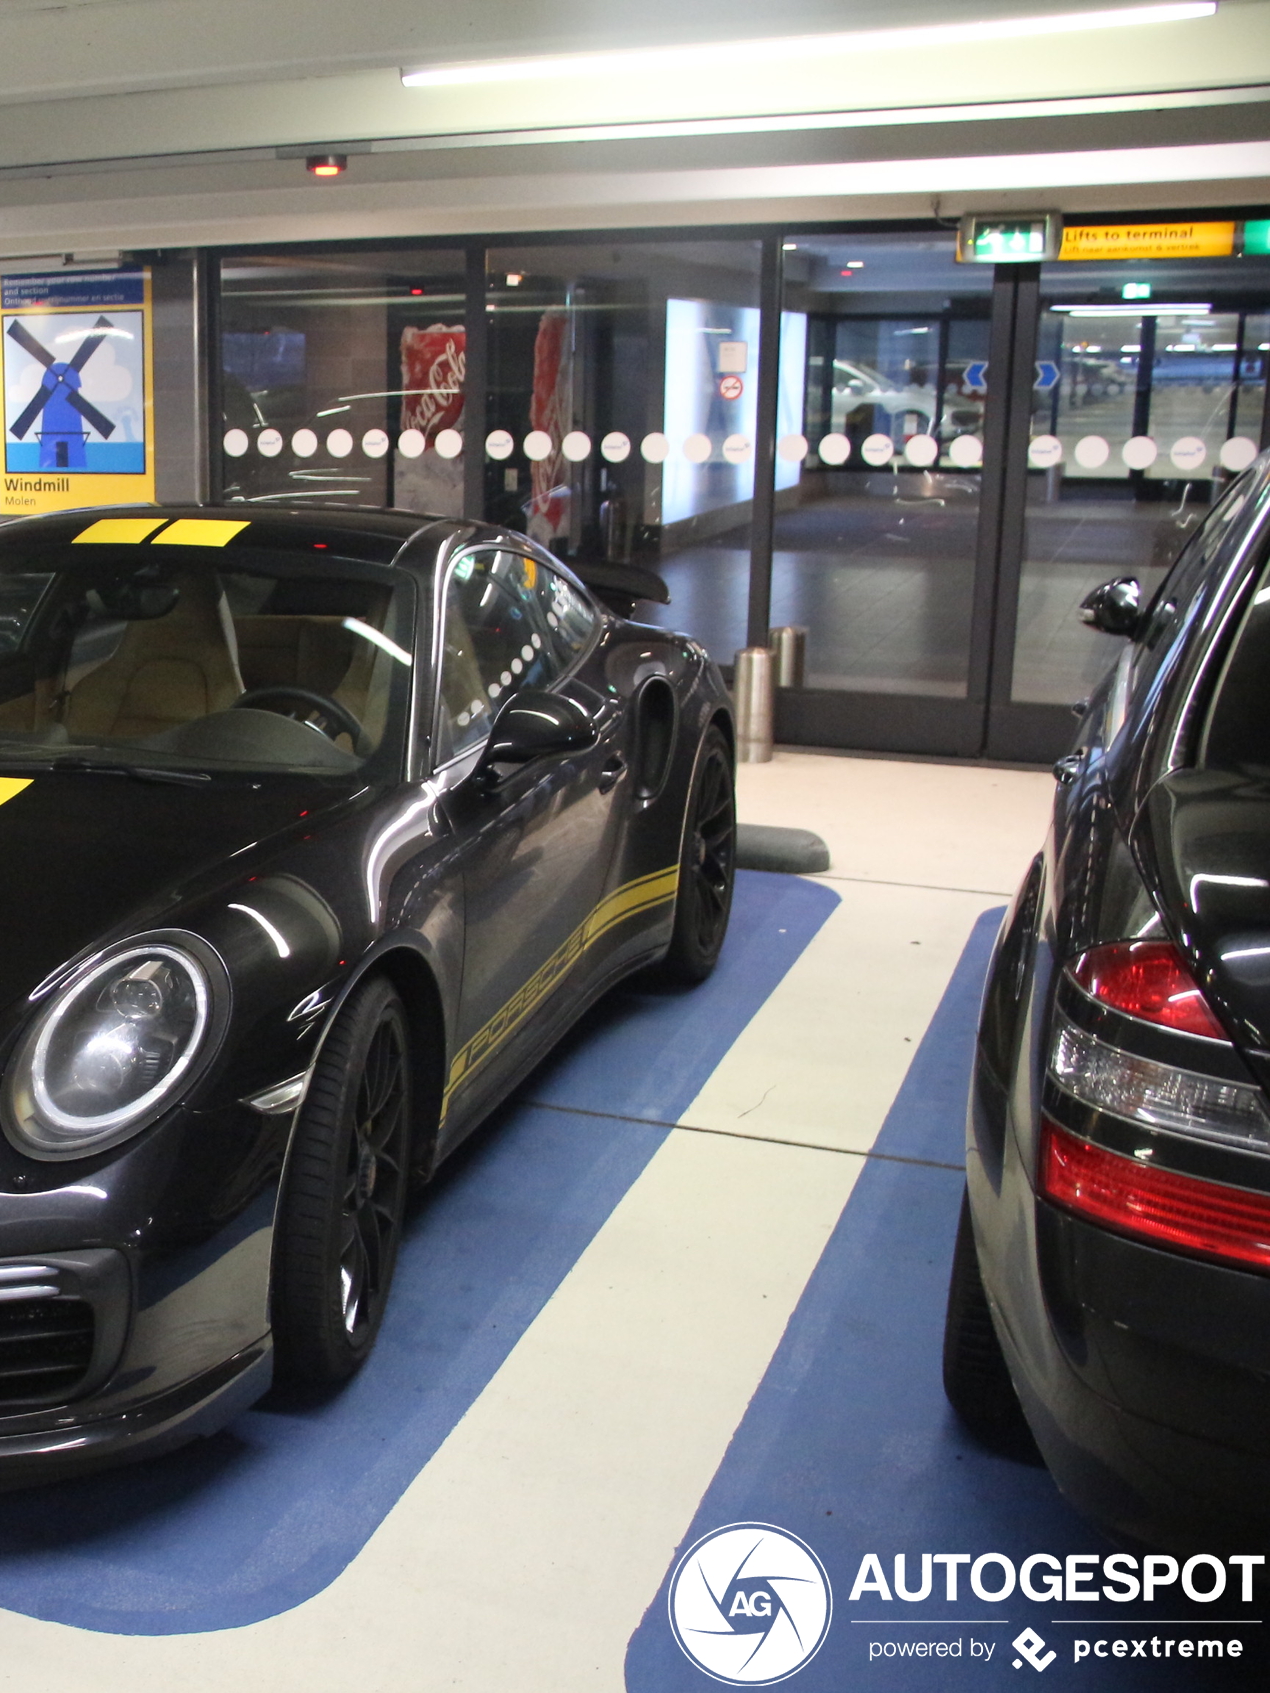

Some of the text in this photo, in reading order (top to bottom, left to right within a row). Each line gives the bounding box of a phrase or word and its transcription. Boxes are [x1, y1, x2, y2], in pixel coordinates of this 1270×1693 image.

[1065, 226, 1194, 242] Lifts to terminal
[46, 277, 65, 286] your
[4, 287, 49, 296] and section
[4, 296, 36, 306] Onthd
[4, 478, 70, 492] Windmill
[5, 496, 36, 506] Molen
[468, 927, 583, 1066] PORSCHE
